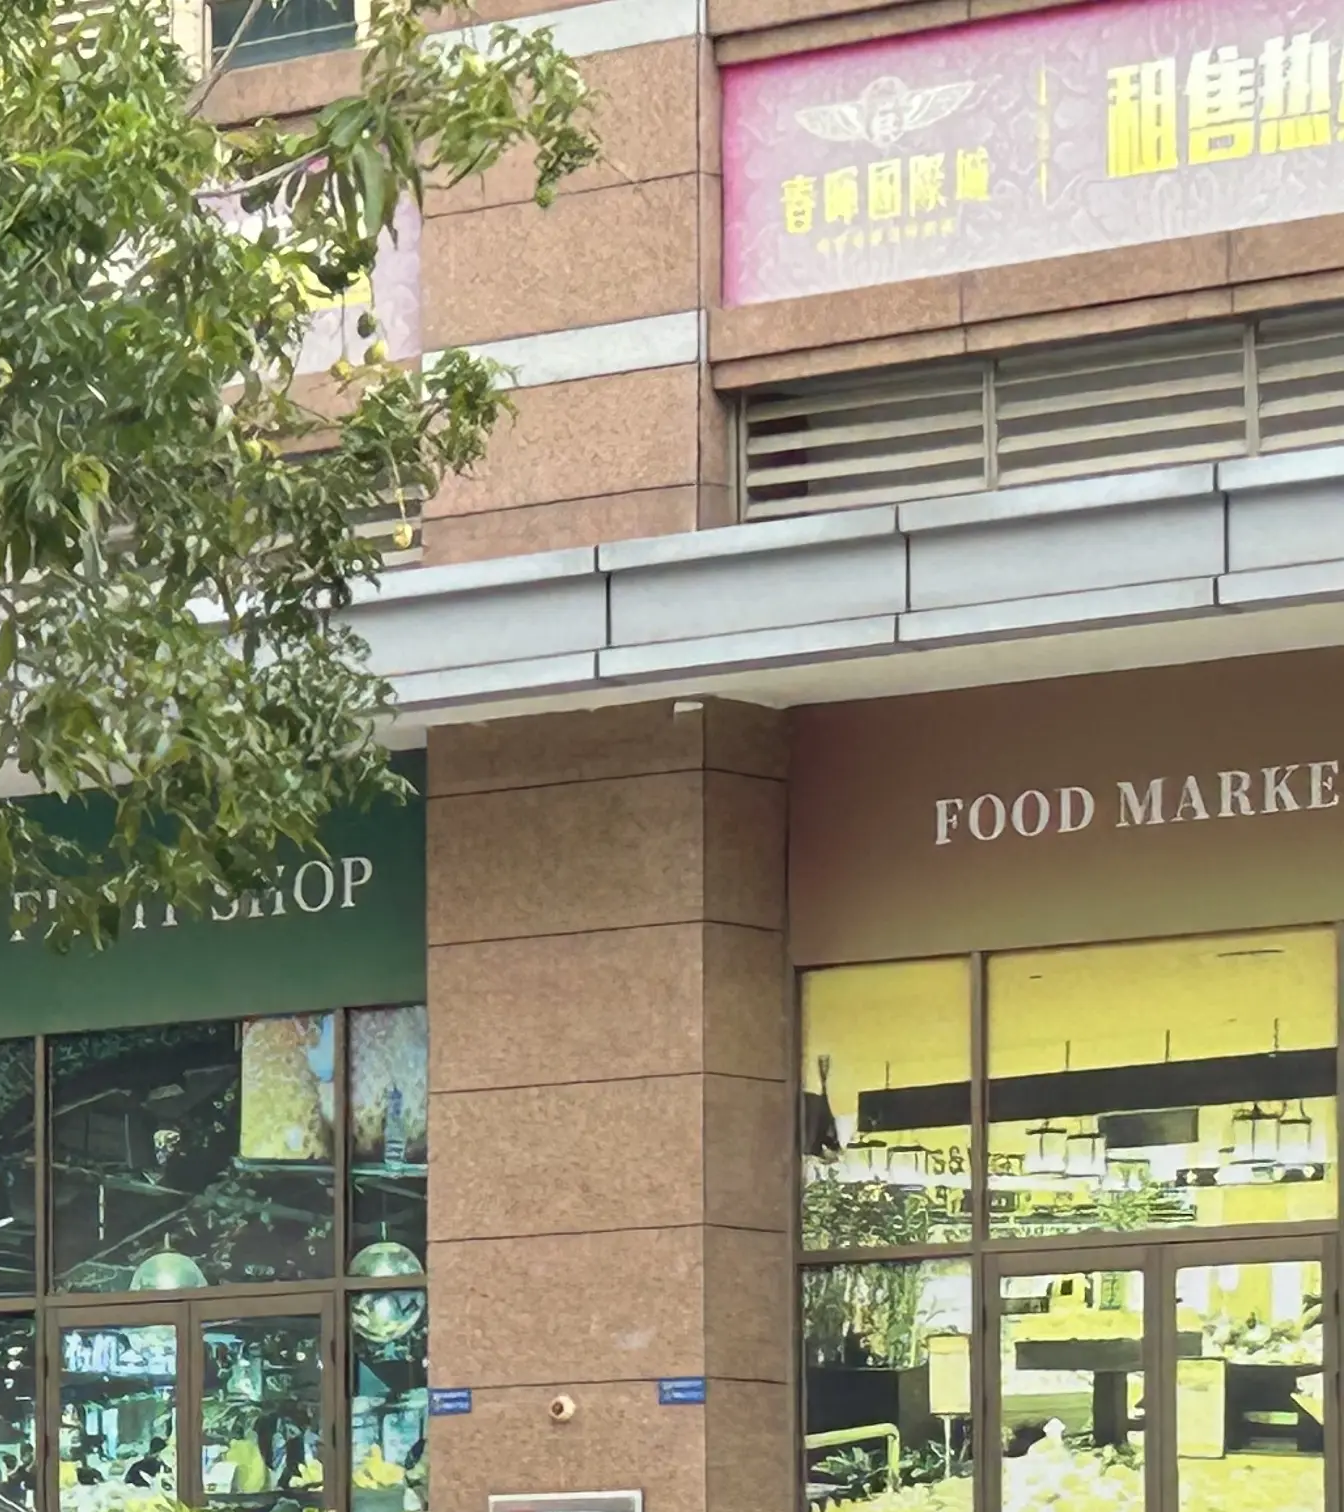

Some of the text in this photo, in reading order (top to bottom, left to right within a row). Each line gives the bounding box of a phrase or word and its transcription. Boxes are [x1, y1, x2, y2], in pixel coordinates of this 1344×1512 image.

[1107, 31, 1344, 178] 租售热
[934, 760, 1340, 845] FOOD MARKE
